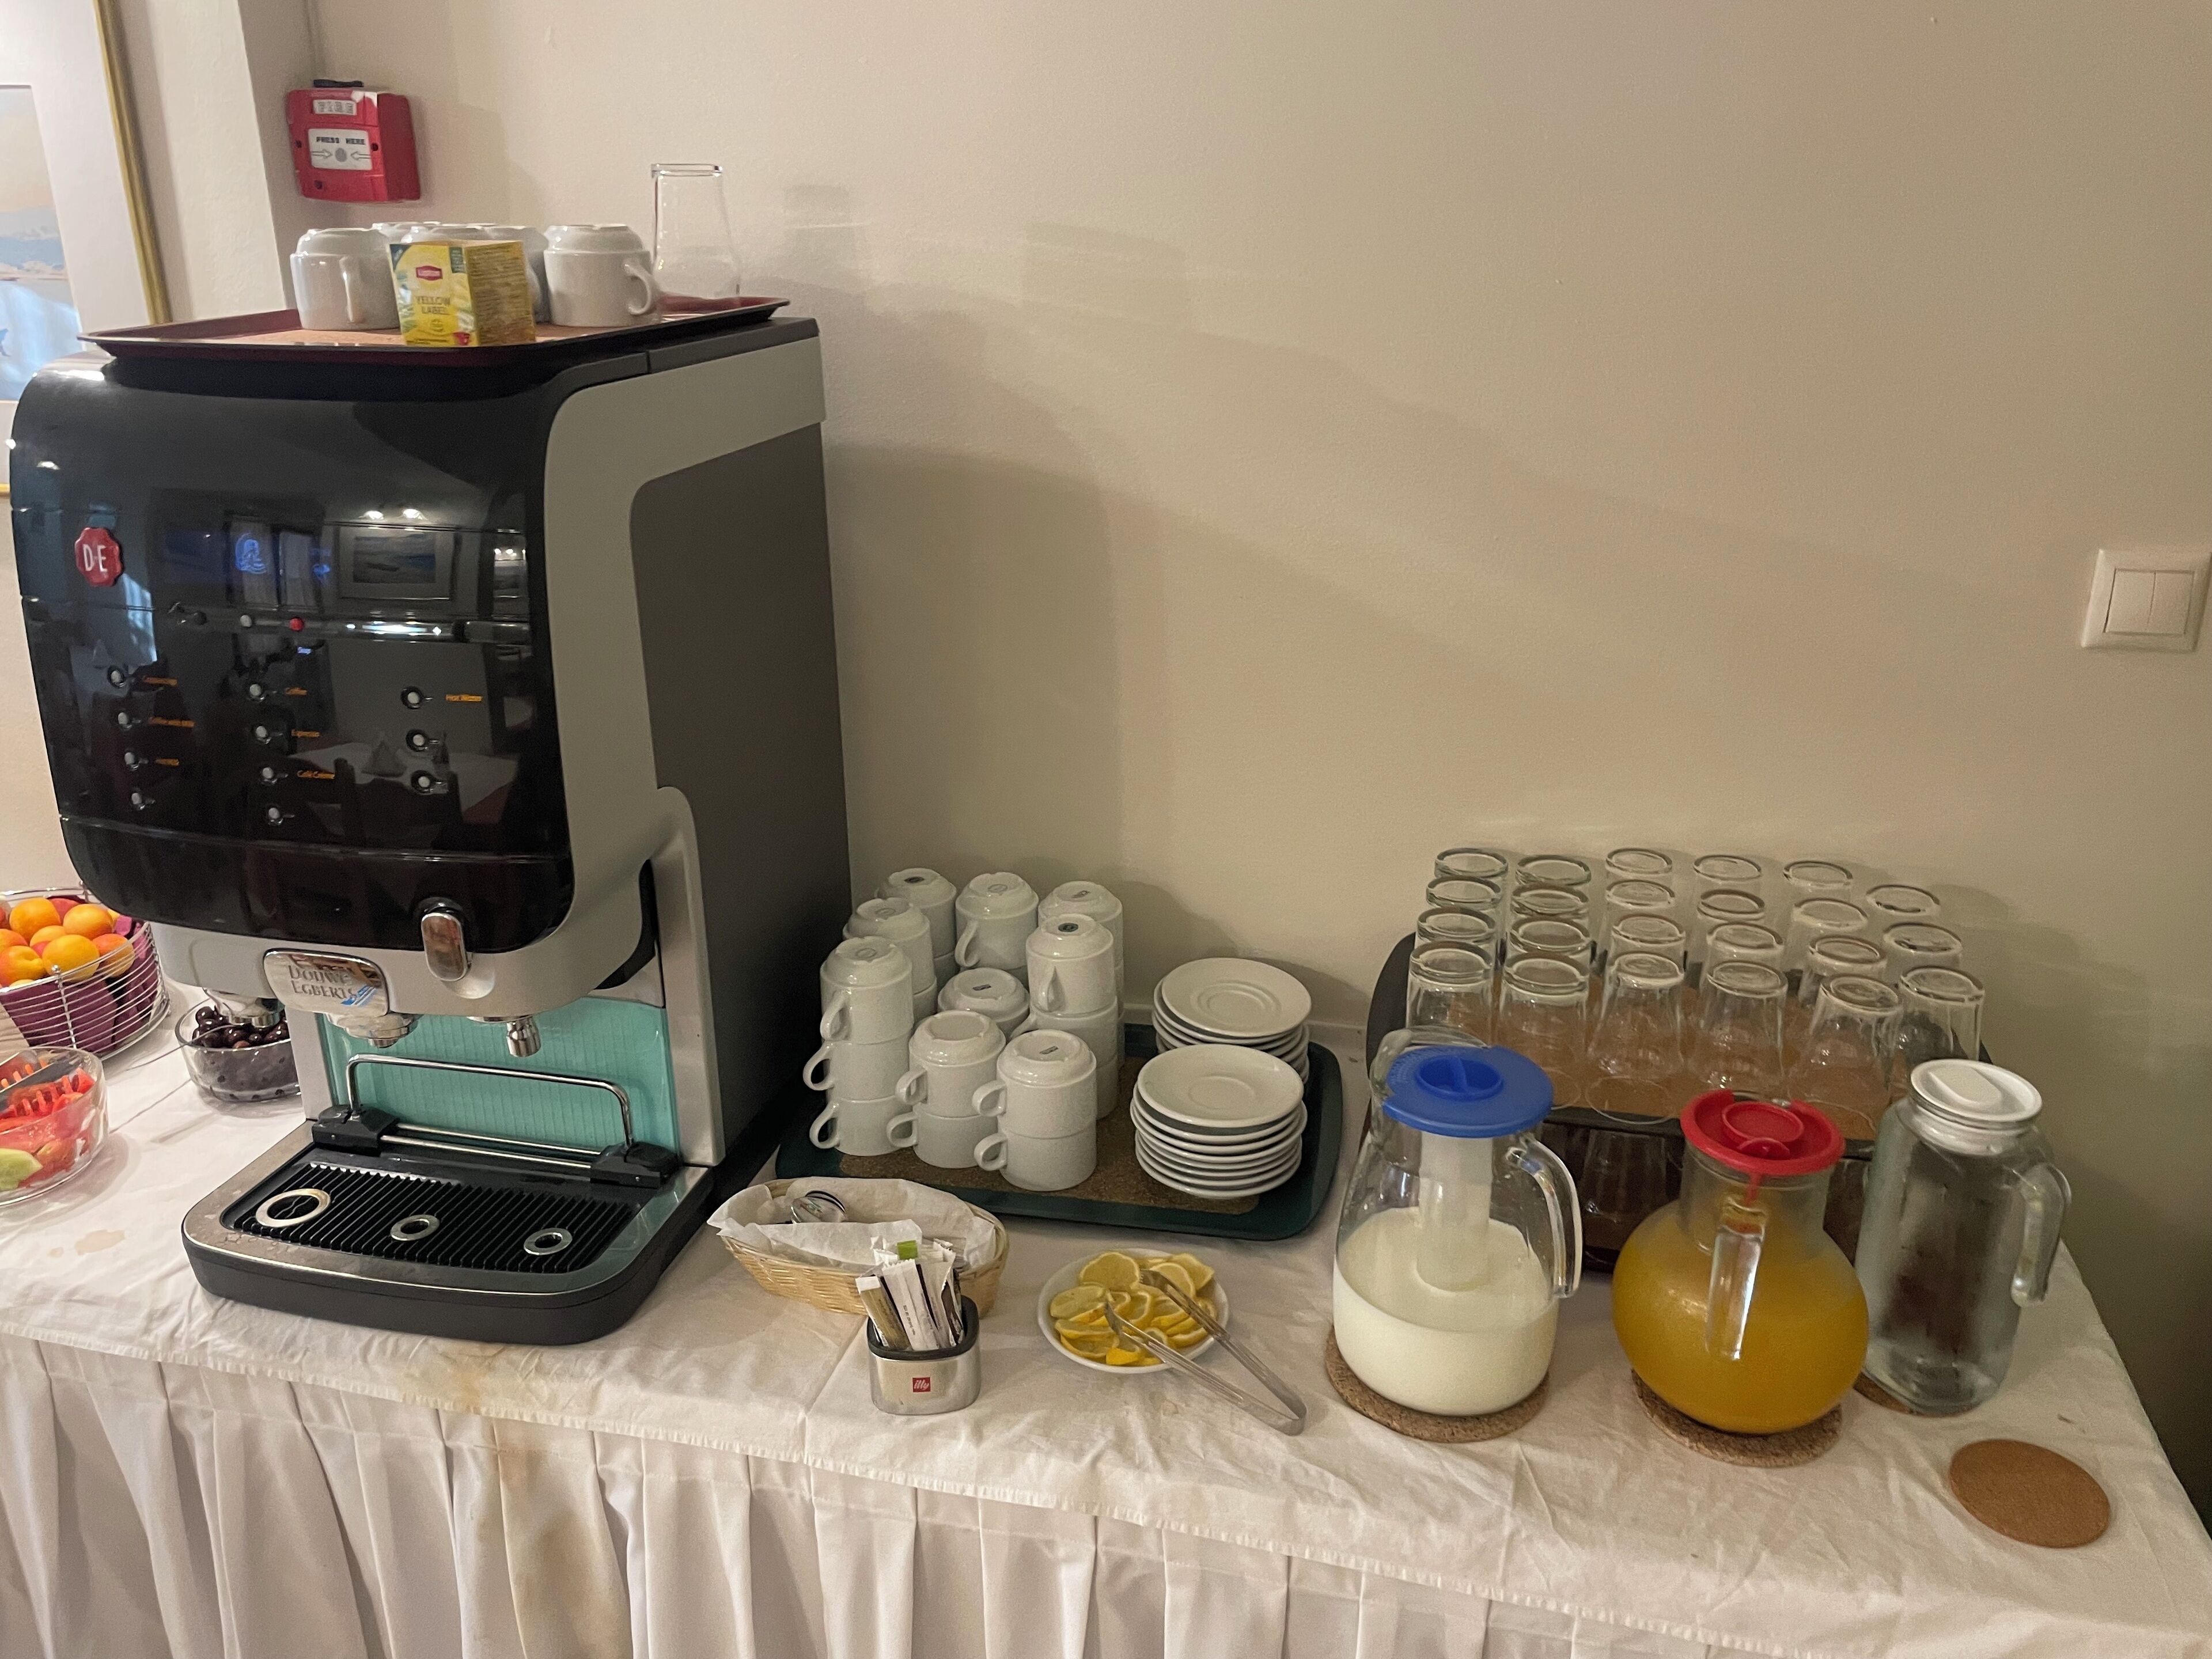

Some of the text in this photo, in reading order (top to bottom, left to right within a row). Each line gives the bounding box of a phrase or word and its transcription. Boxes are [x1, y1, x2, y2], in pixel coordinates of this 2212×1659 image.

[415, 296, 450, 305] YELLOW
[421, 306, 452, 316] LABEL
[914, 1379, 930, 1391] illy
